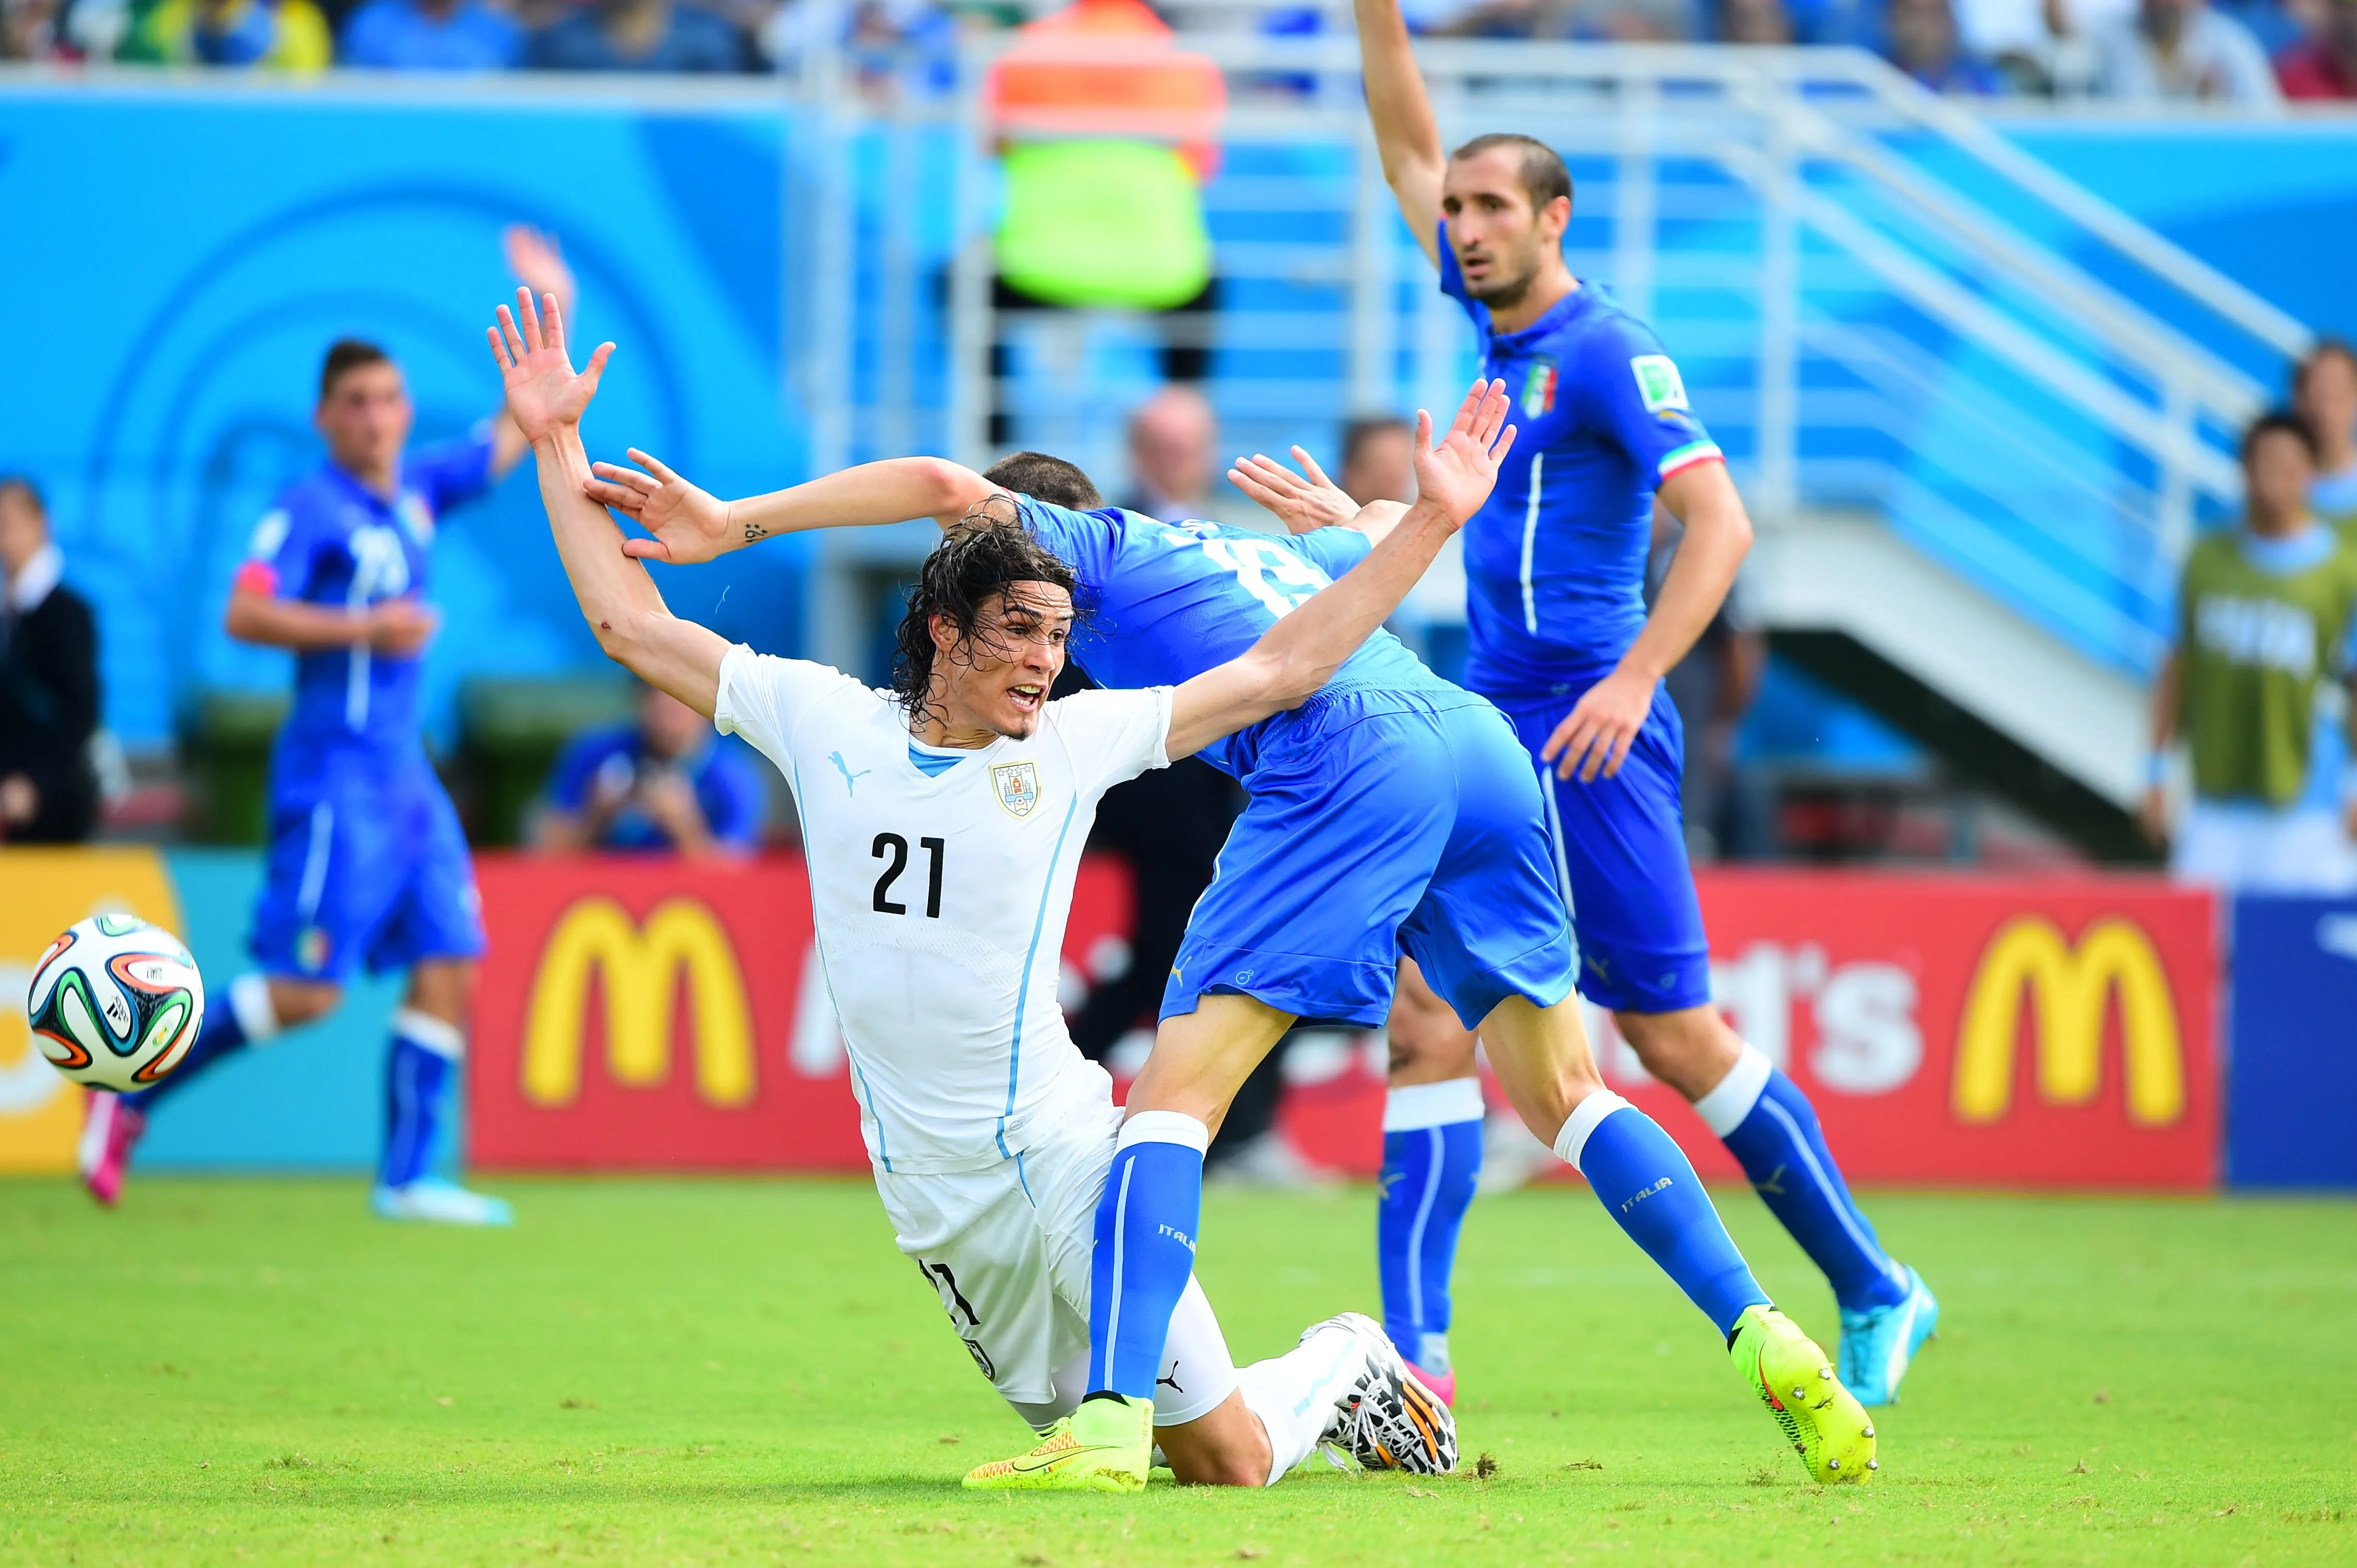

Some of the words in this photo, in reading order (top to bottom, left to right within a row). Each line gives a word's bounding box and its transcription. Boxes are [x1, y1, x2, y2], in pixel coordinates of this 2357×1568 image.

[872, 833, 945, 918] 21
[1621, 1177, 1673, 1213] ITALIA
[1158, 1224, 1196, 1256] ITALIA
